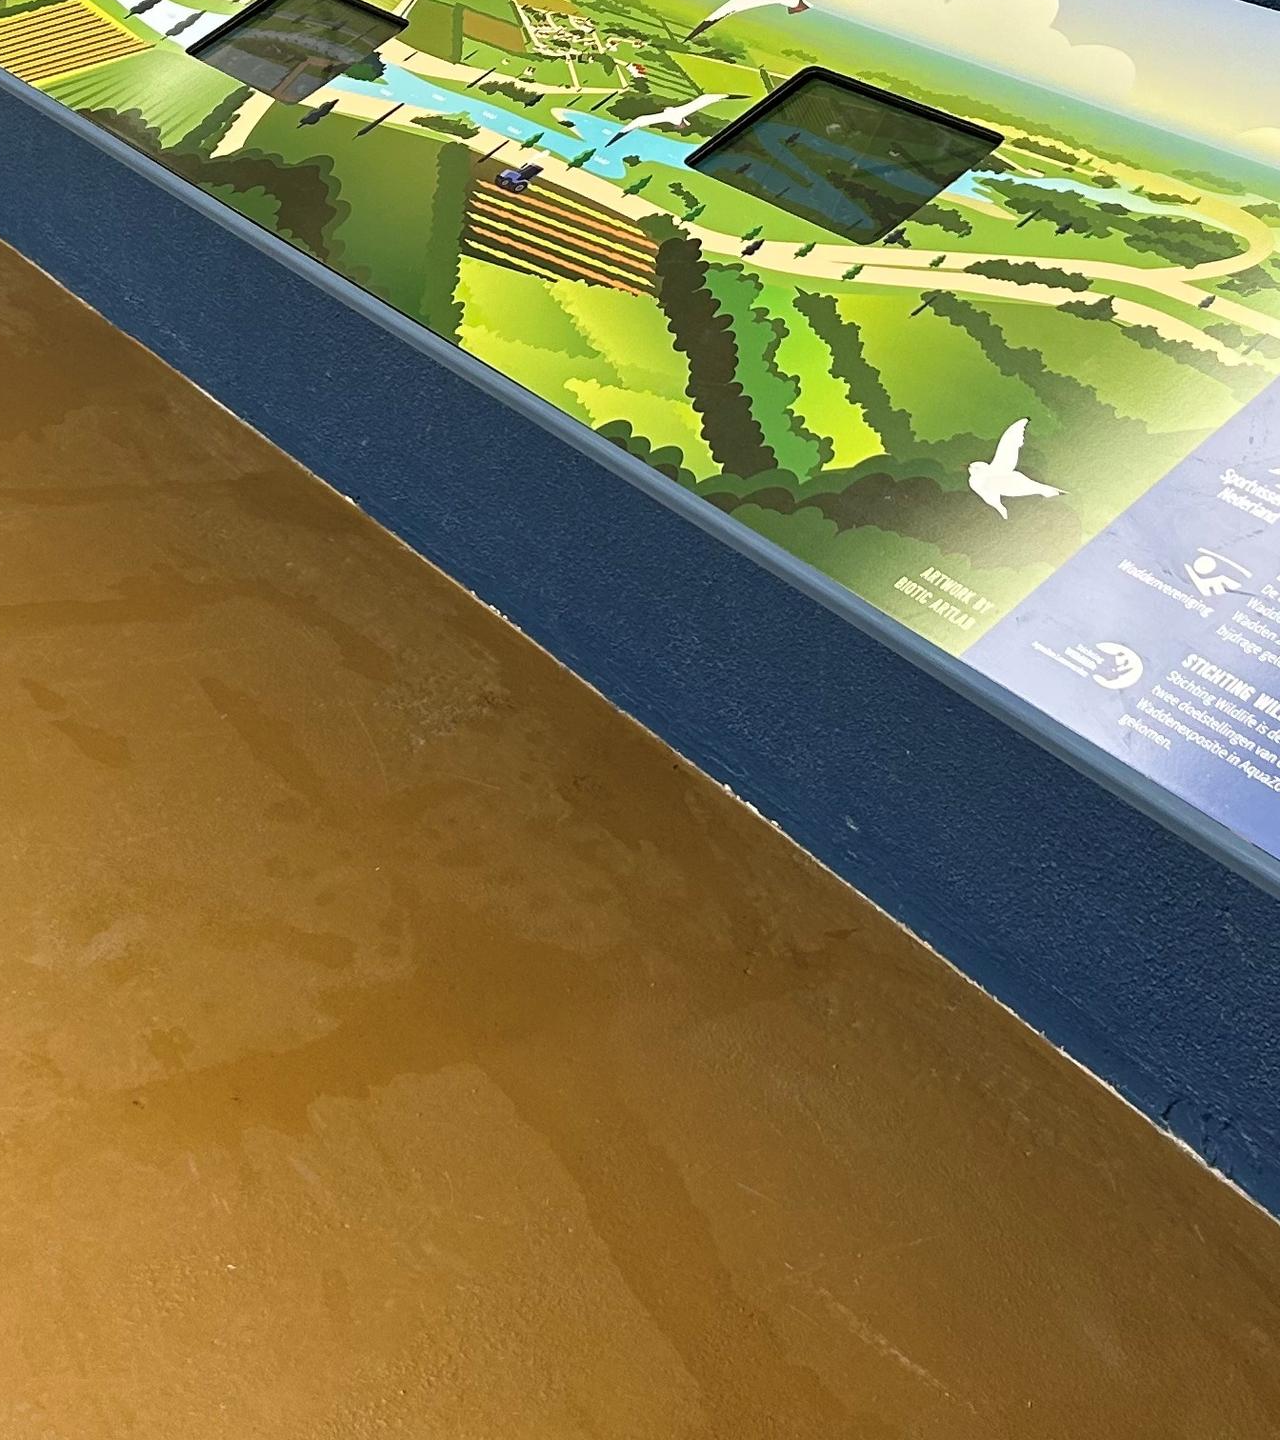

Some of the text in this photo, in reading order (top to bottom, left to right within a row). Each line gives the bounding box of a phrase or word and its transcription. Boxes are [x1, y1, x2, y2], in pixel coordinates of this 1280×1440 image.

[894, 576, 978, 631] BIOTIC ARTLAB
[920, 566, 995, 615] ARTWORK BY
[1117, 559, 1215, 618] Waddenvereniging
[1180, 653, 1258, 701] STICHTING
[1253, 745, 1279, 764] van
